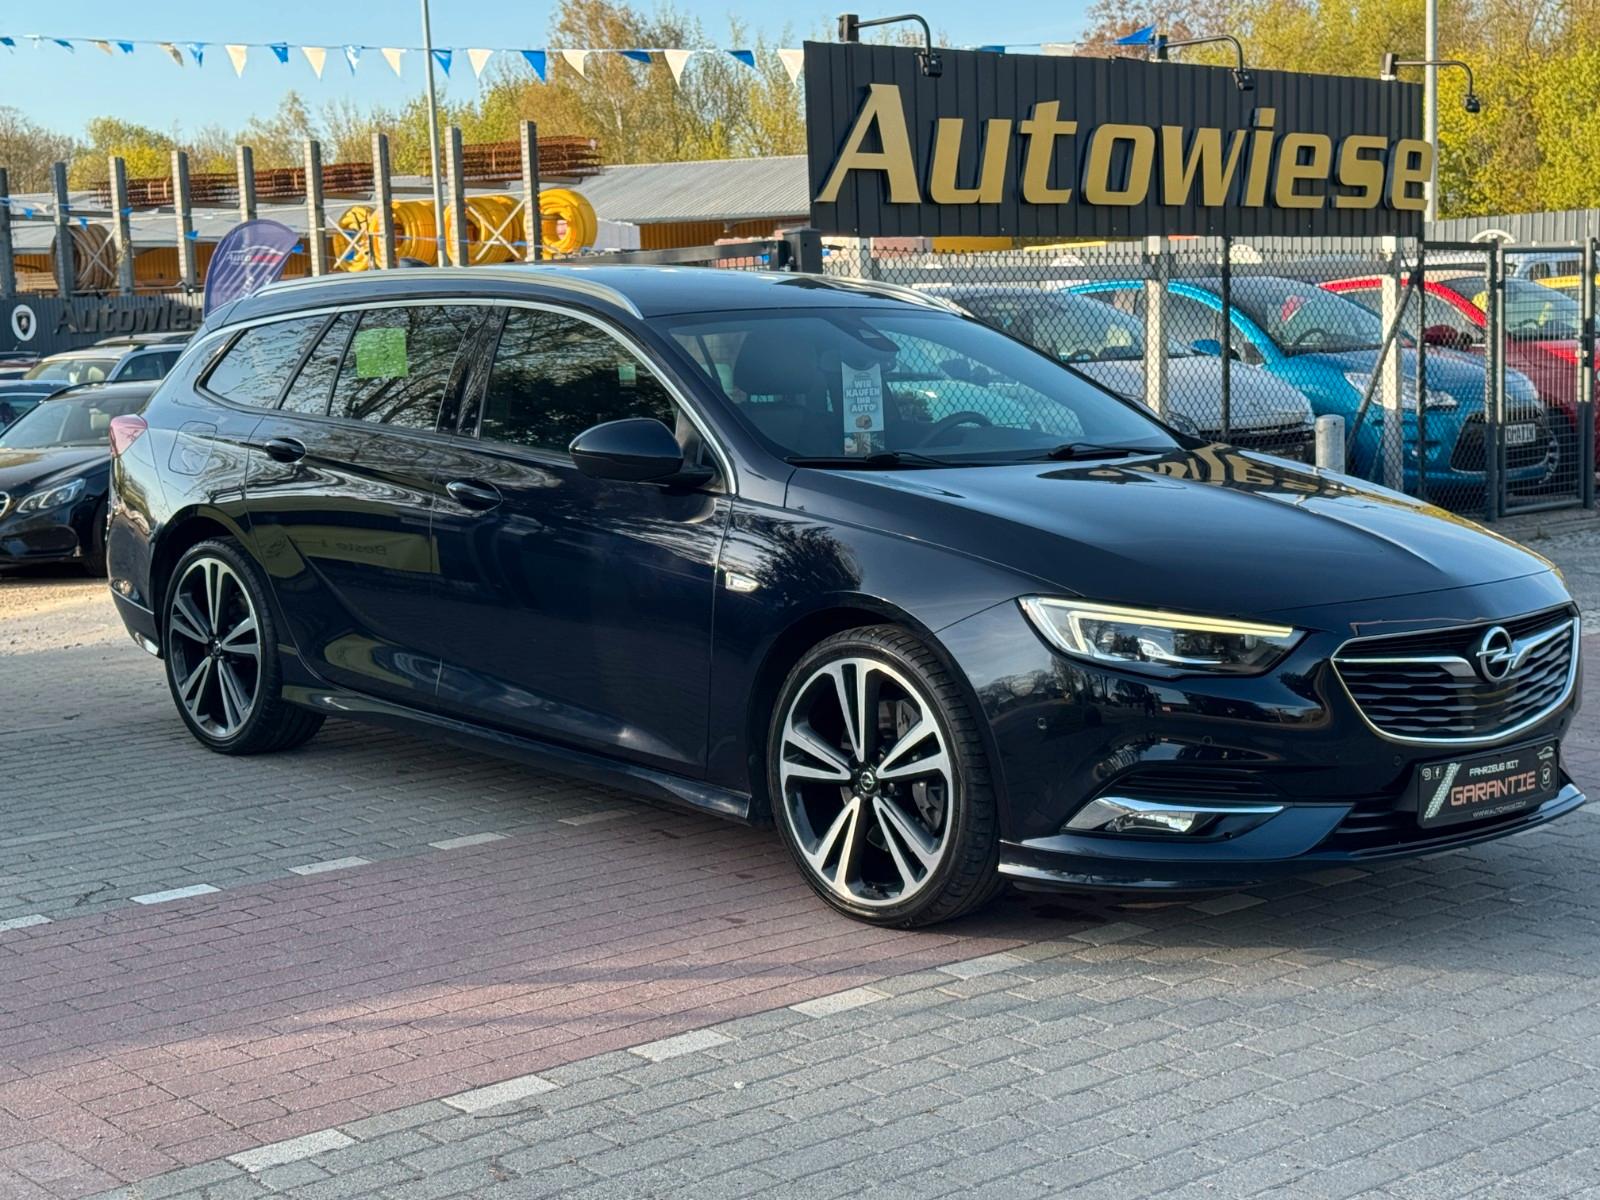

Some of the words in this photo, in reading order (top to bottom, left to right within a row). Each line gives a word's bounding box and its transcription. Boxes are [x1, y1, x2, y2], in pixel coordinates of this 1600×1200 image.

[815, 83, 1434, 211] Autowiese
[854, 380, 872, 389] WIR
[846, 388, 880, 397] KAUFEN
[857, 396, 871, 404] IHR
[1469, 762, 1505, 777] FAHRZEUG
[1506, 760, 1519, 771] MIT
[1450, 771, 1536, 806] GARANTIE
